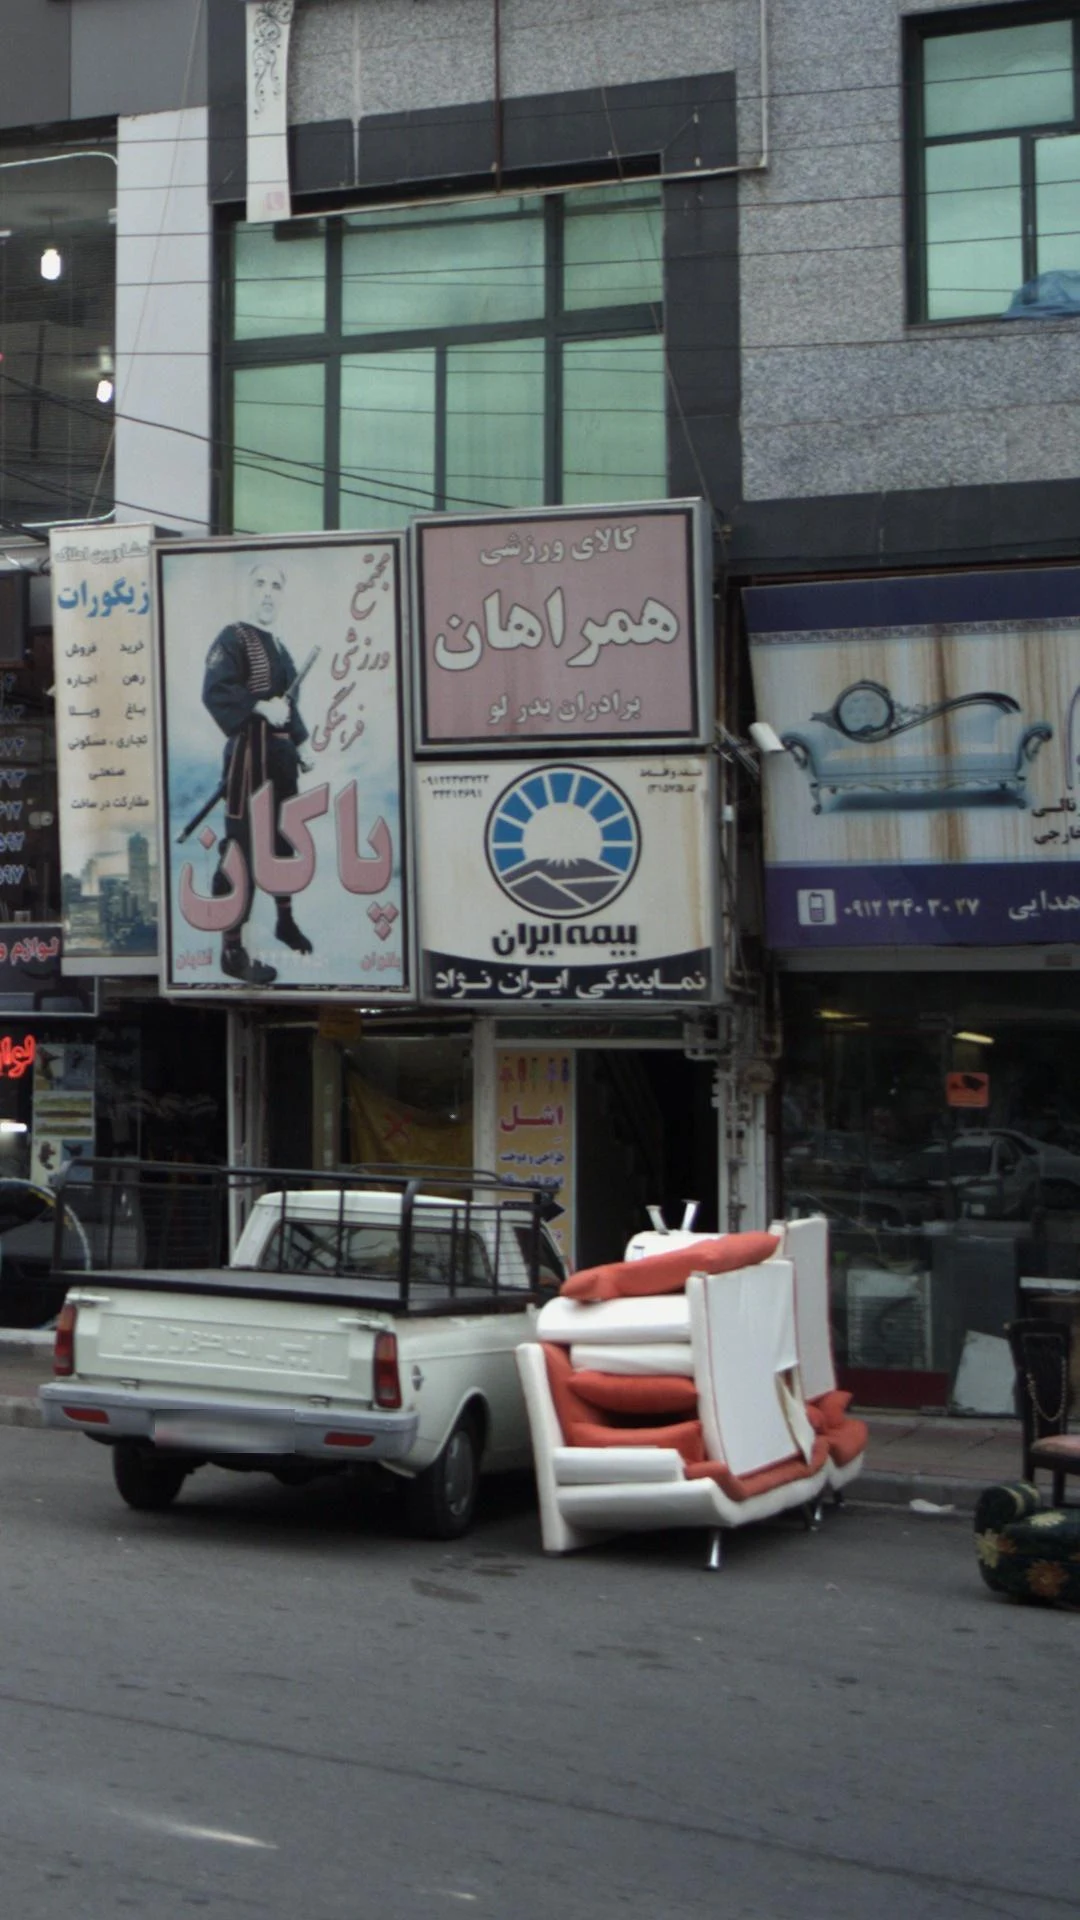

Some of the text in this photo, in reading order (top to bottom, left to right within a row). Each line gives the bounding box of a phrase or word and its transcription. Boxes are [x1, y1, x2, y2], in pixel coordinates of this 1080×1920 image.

[479, 525, 638, 566] کالای ورزشی
[57, 576, 150, 618] زیگورات
[350, 552, 391, 621] مجتمع
[65, 640, 145, 658] خرید فروش
[433, 585, 681, 672] همراهان
[331, 627, 391, 681] ورزشی
[66, 674, 145, 688] رهن اجاره
[311, 681, 365, 752] فرهنگی
[558, 690, 642, 722] برادران
[178, 778, 400, 941] پاکان
[492, 922, 638, 957] بیمه ایران
[434, 967, 708, 999] نمایندگی ایران نژاد
